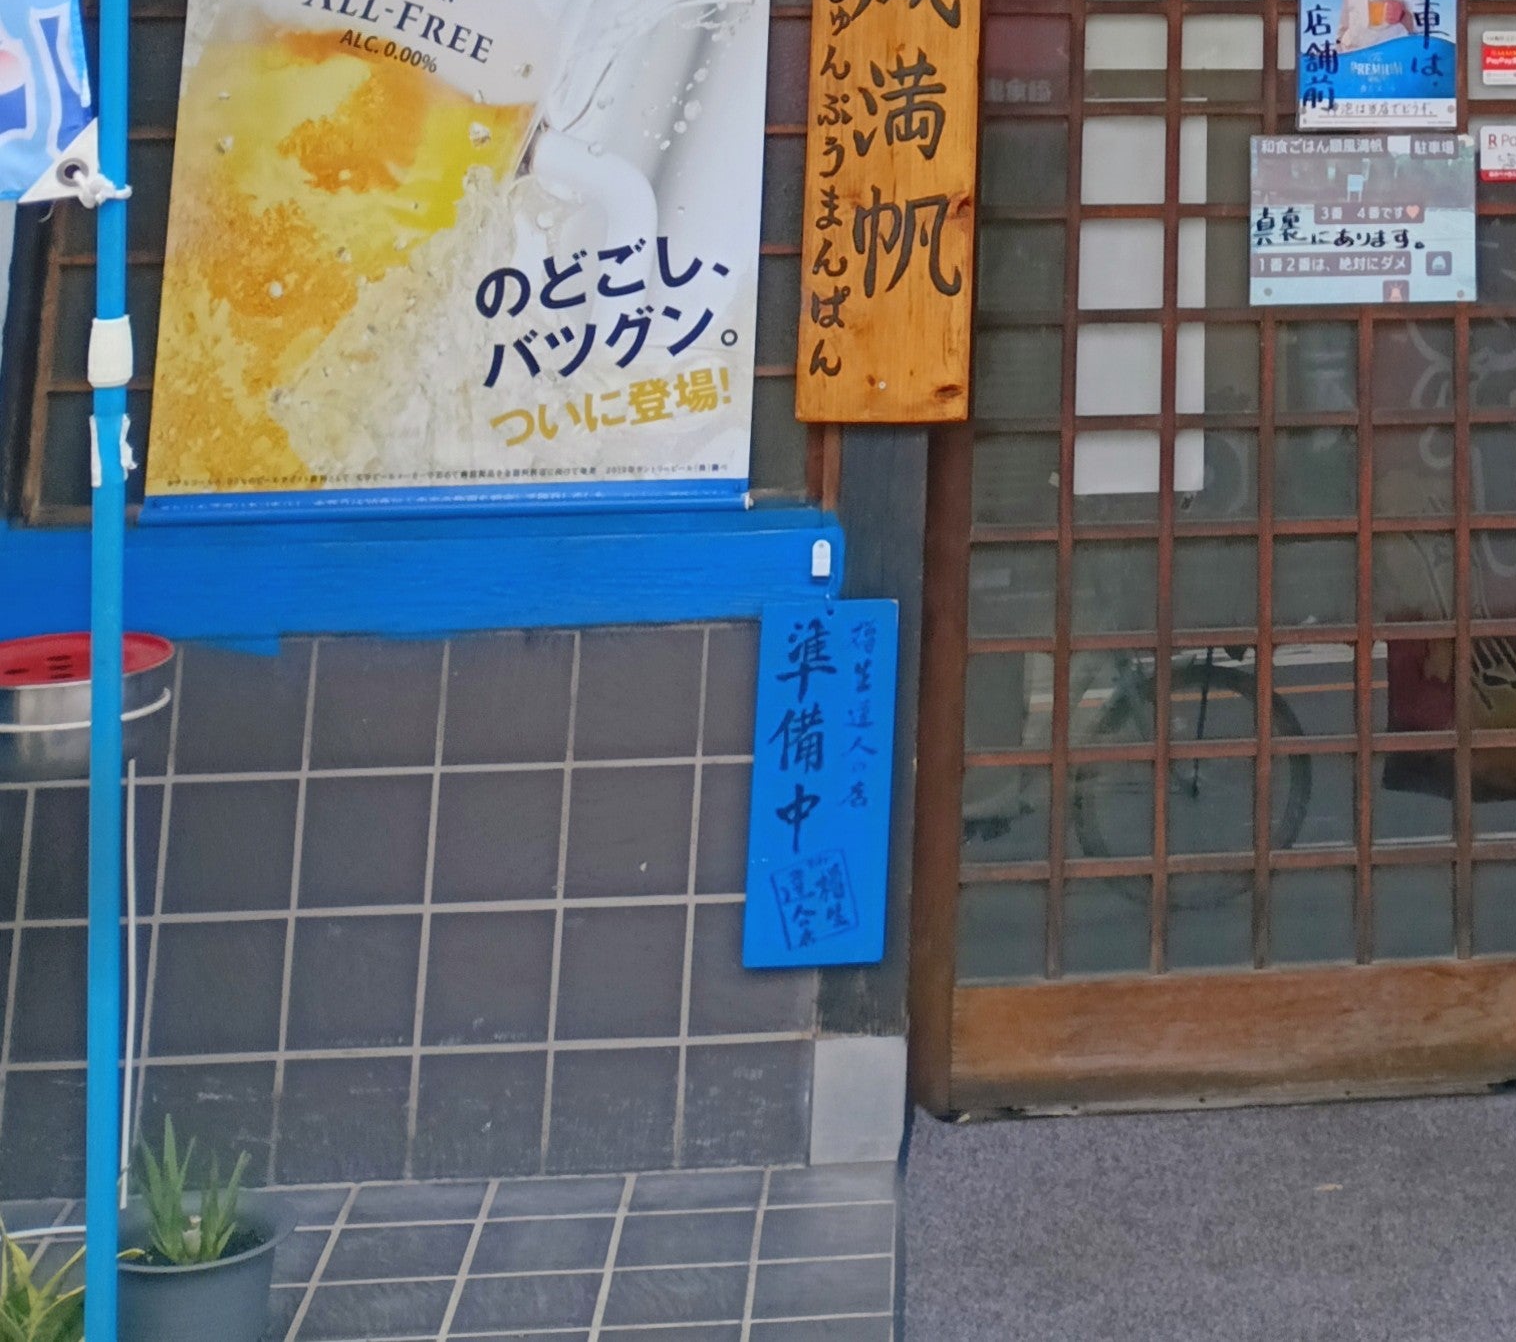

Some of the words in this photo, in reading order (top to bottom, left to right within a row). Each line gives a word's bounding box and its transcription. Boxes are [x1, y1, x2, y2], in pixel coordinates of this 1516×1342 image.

[340, 29, 379, 54] ALC.
[384, 41, 437, 74] 0.00%
[1414, 140, 1455, 155] 駐車場
[476, 236, 730, 319] のどごし、
[483, 305, 738, 388] バツグン。
[489, 367, 732, 448] ついに登場!
[769, 619, 838, 854] 準備中
